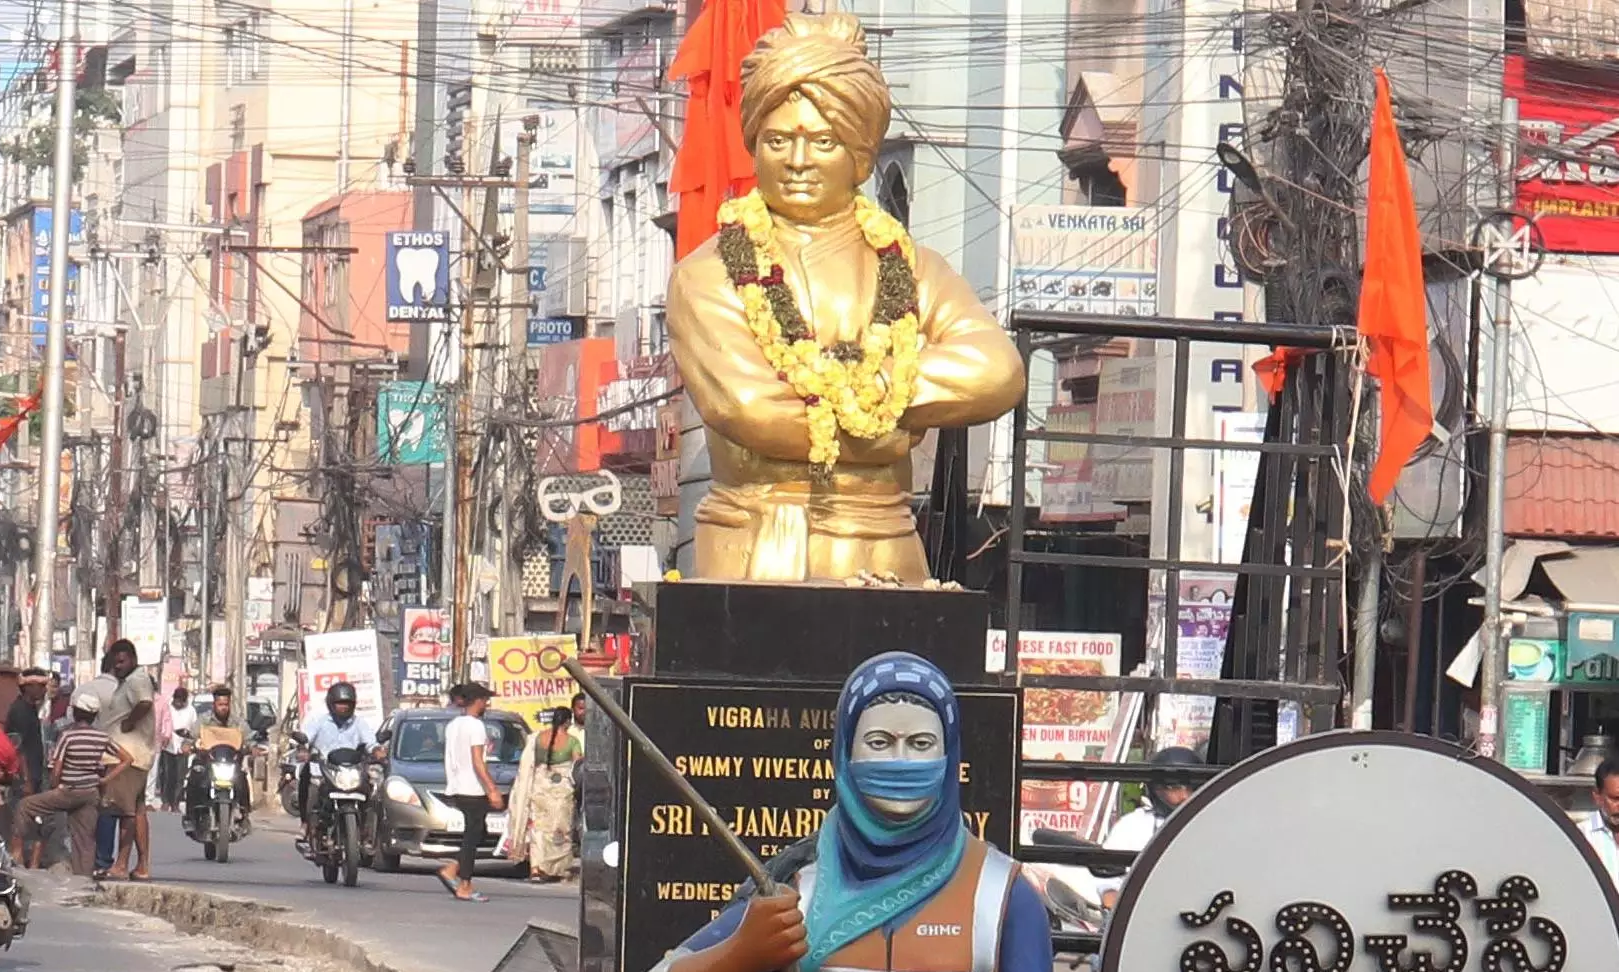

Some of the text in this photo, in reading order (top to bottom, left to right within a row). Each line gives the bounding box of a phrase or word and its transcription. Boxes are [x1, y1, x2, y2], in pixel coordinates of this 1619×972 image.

[1048, 214, 1116, 231] VENKATA
[392, 233, 443, 246] ETHOS
[389, 306, 445, 318] DENTAL
[1049, 640, 1079, 655] FAST
[1082, 641, 1114, 656] FOOD
[406, 663, 441, 680] Eth
[494, 678, 574, 697] LENSMART
[706, 706, 791, 730] VIGRAHA
[1040, 728, 1065, 742] DUM
[813, 739, 831, 750] OF
[675, 755, 744, 778] SWAMY
[812, 789, 830, 800] BY
[650, 804, 693, 836] SRI
[916, 923, 962, 937] GHMC
